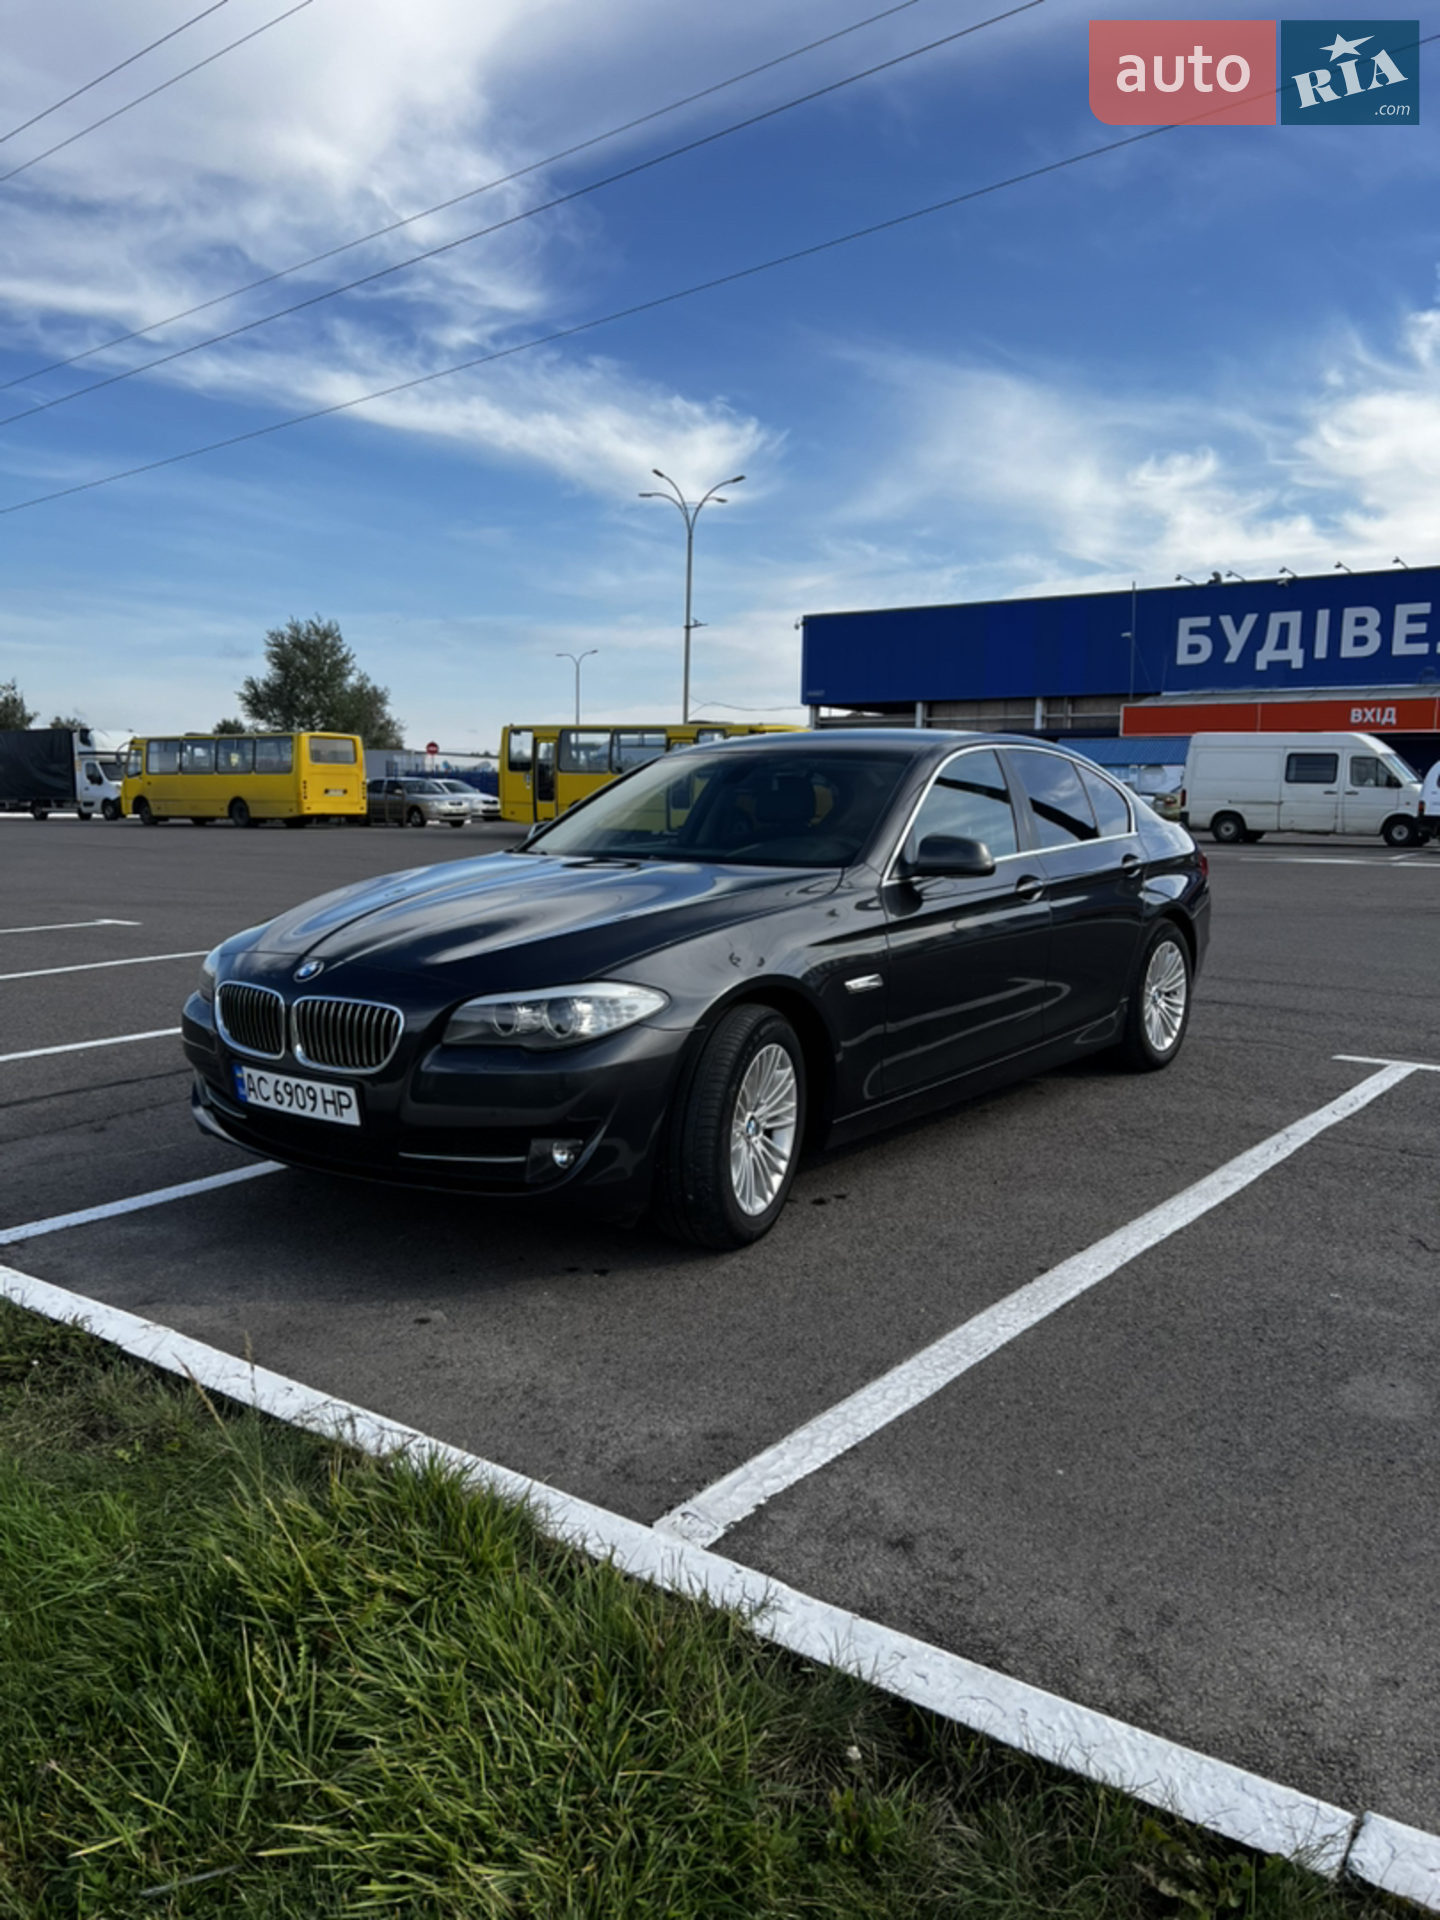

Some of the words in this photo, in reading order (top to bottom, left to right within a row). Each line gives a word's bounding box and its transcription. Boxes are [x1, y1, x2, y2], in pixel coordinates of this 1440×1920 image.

[1176, 602, 1440, 671] БУДІВЕ
[1350, 707, 1397, 726] ВХІД
[247, 1073, 271, 1102] AC
[273, 1079, 318, 1112] 6909
[320, 1087, 353, 1118] HP
